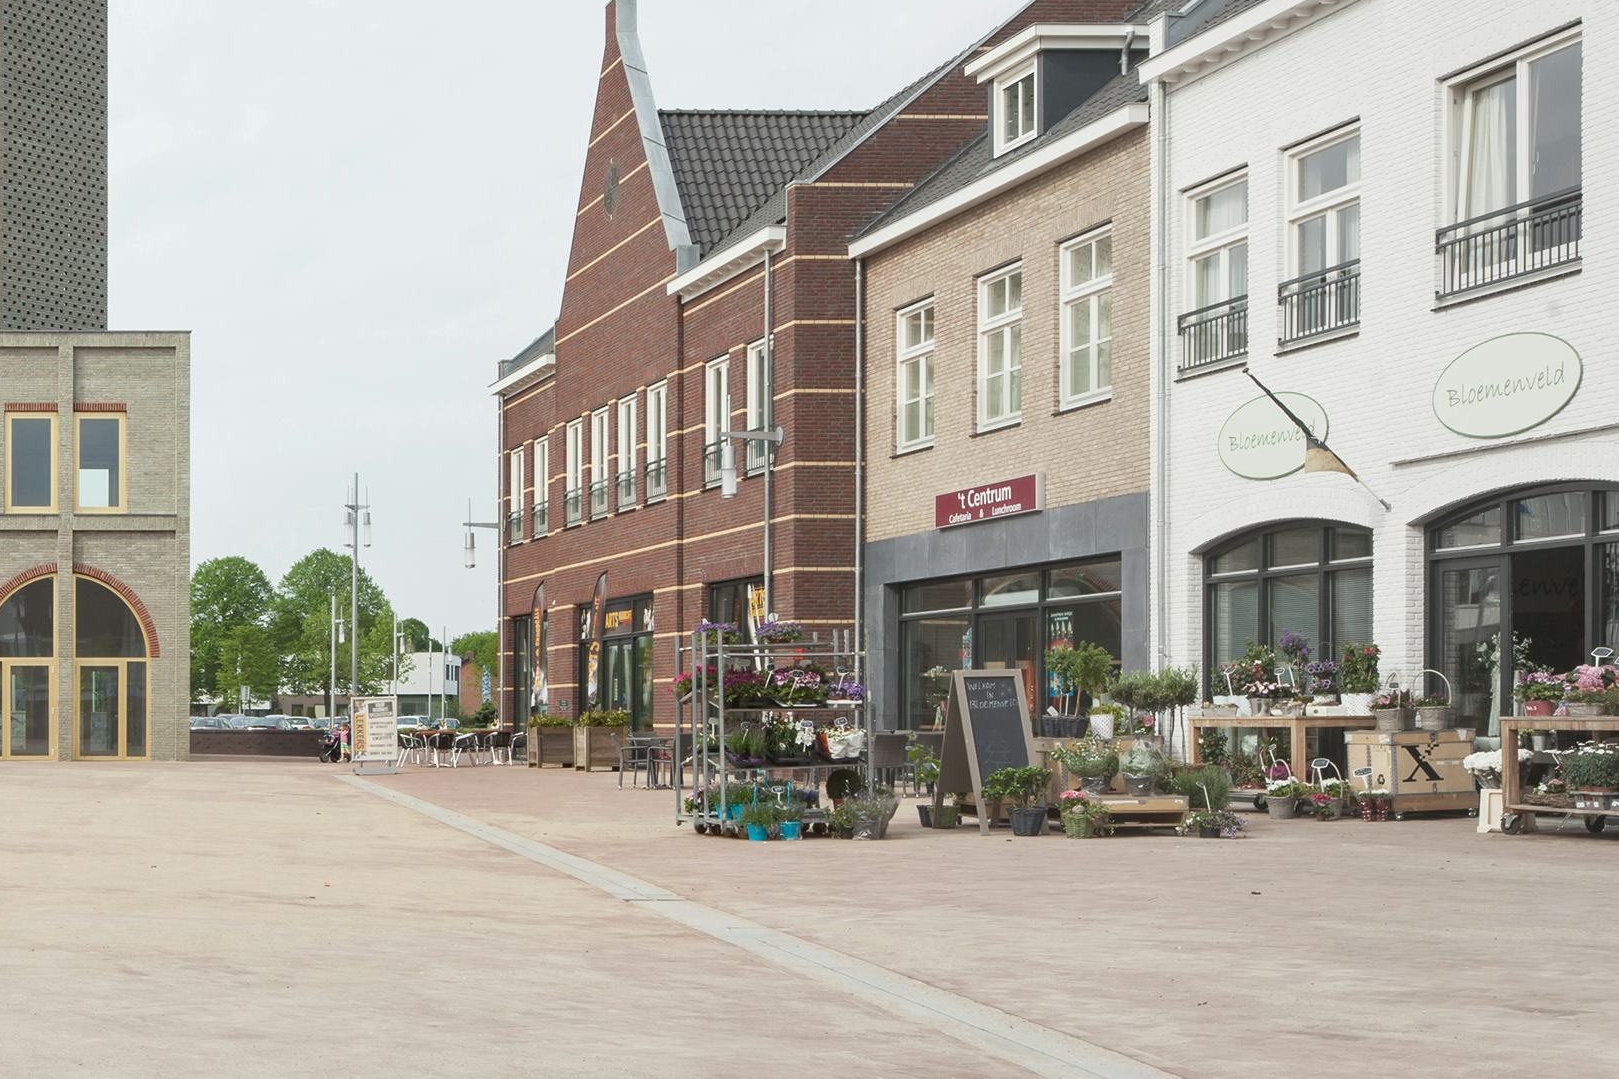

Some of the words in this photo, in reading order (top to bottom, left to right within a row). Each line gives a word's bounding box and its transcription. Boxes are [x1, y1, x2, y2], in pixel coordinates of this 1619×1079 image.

[1446, 360, 1565, 407] Bloemenveld
[1228, 417, 1315, 452] Bloemenved
[949, 511, 972, 524] Cafetaria
[979, 508, 984, 518] &
[992, 503, 1021, 516] Lunchroom
[958, 492, 965, 509] 't
[968, 486, 1011, 508] Centrum
[356, 714, 364, 750] LEKKERS
